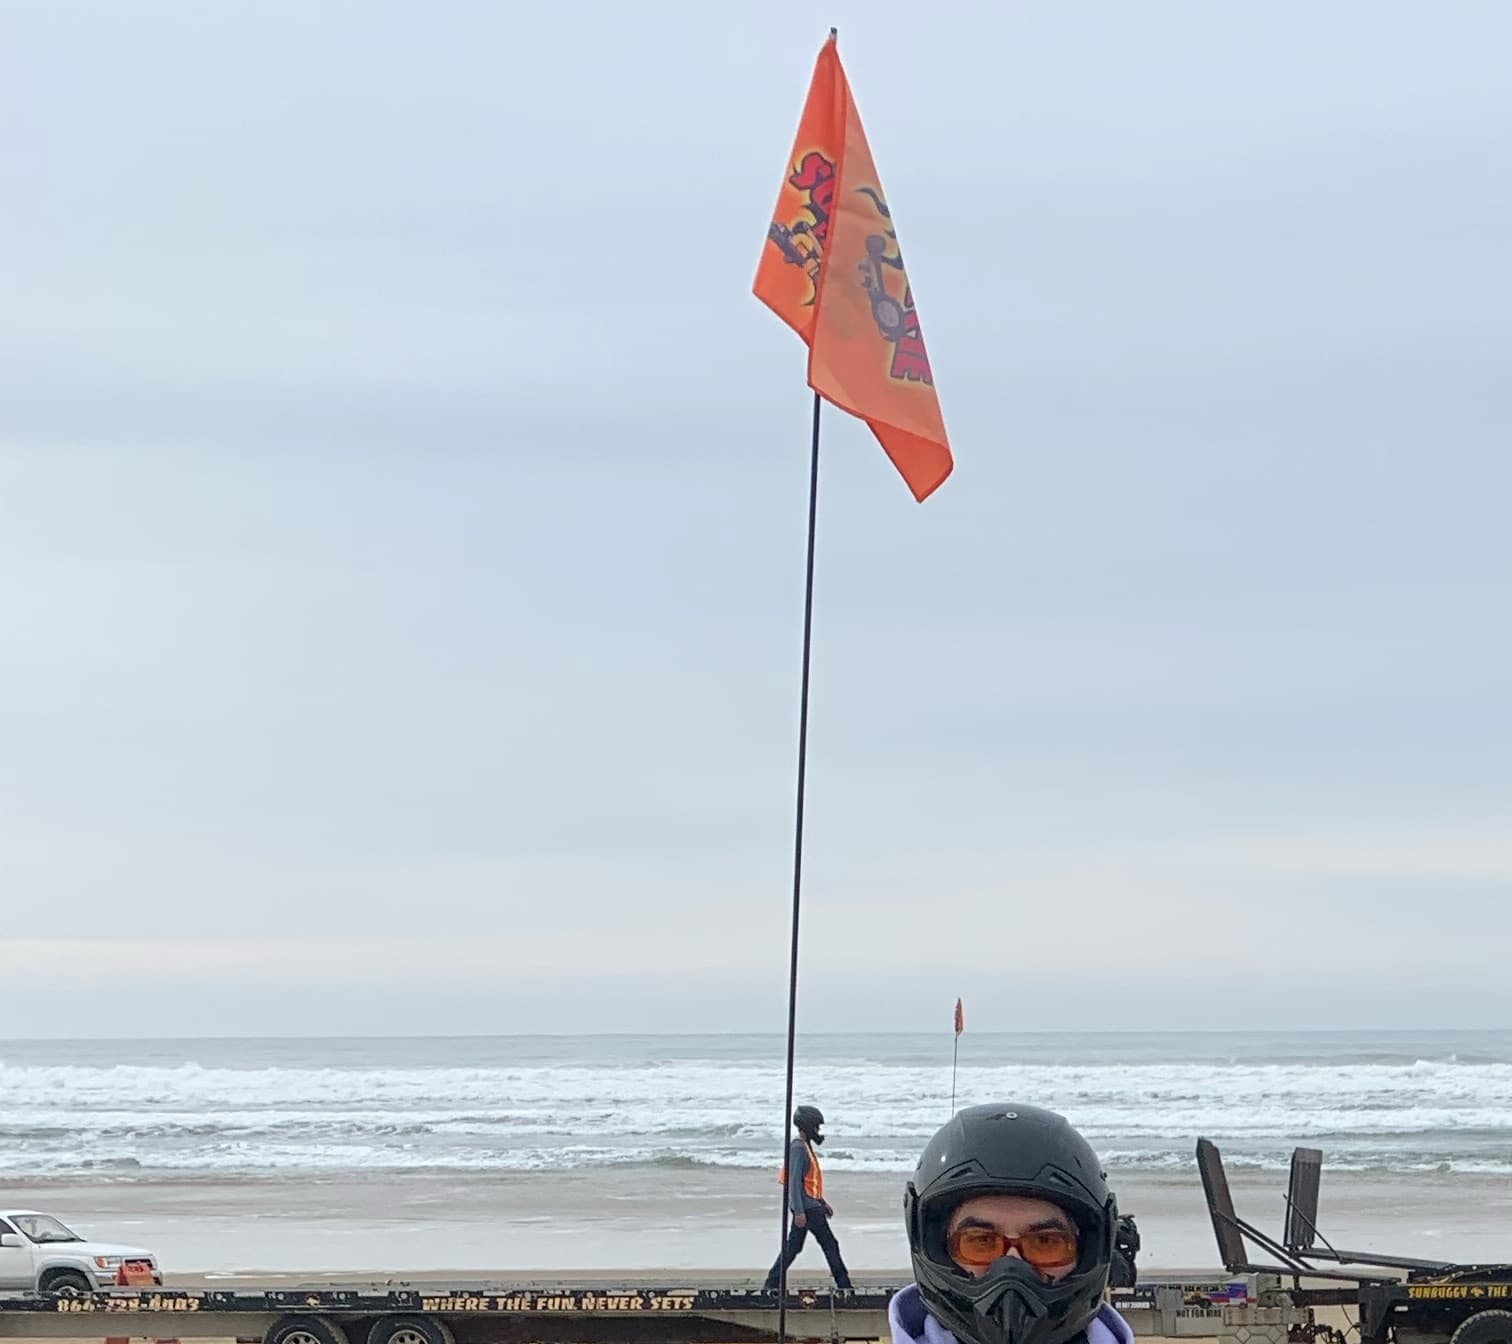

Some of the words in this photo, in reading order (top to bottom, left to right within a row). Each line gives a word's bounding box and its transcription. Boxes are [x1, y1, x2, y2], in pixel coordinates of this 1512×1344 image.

[1488, 1286, 1507, 1297] THE
[422, 1297, 490, 1311] WHERE
[496, 1297, 532, 1311] THE
[536, 1297, 576, 1310] FUN
[582, 1297, 645, 1311] NEVER
[650, 1297, 695, 1310] SETS
